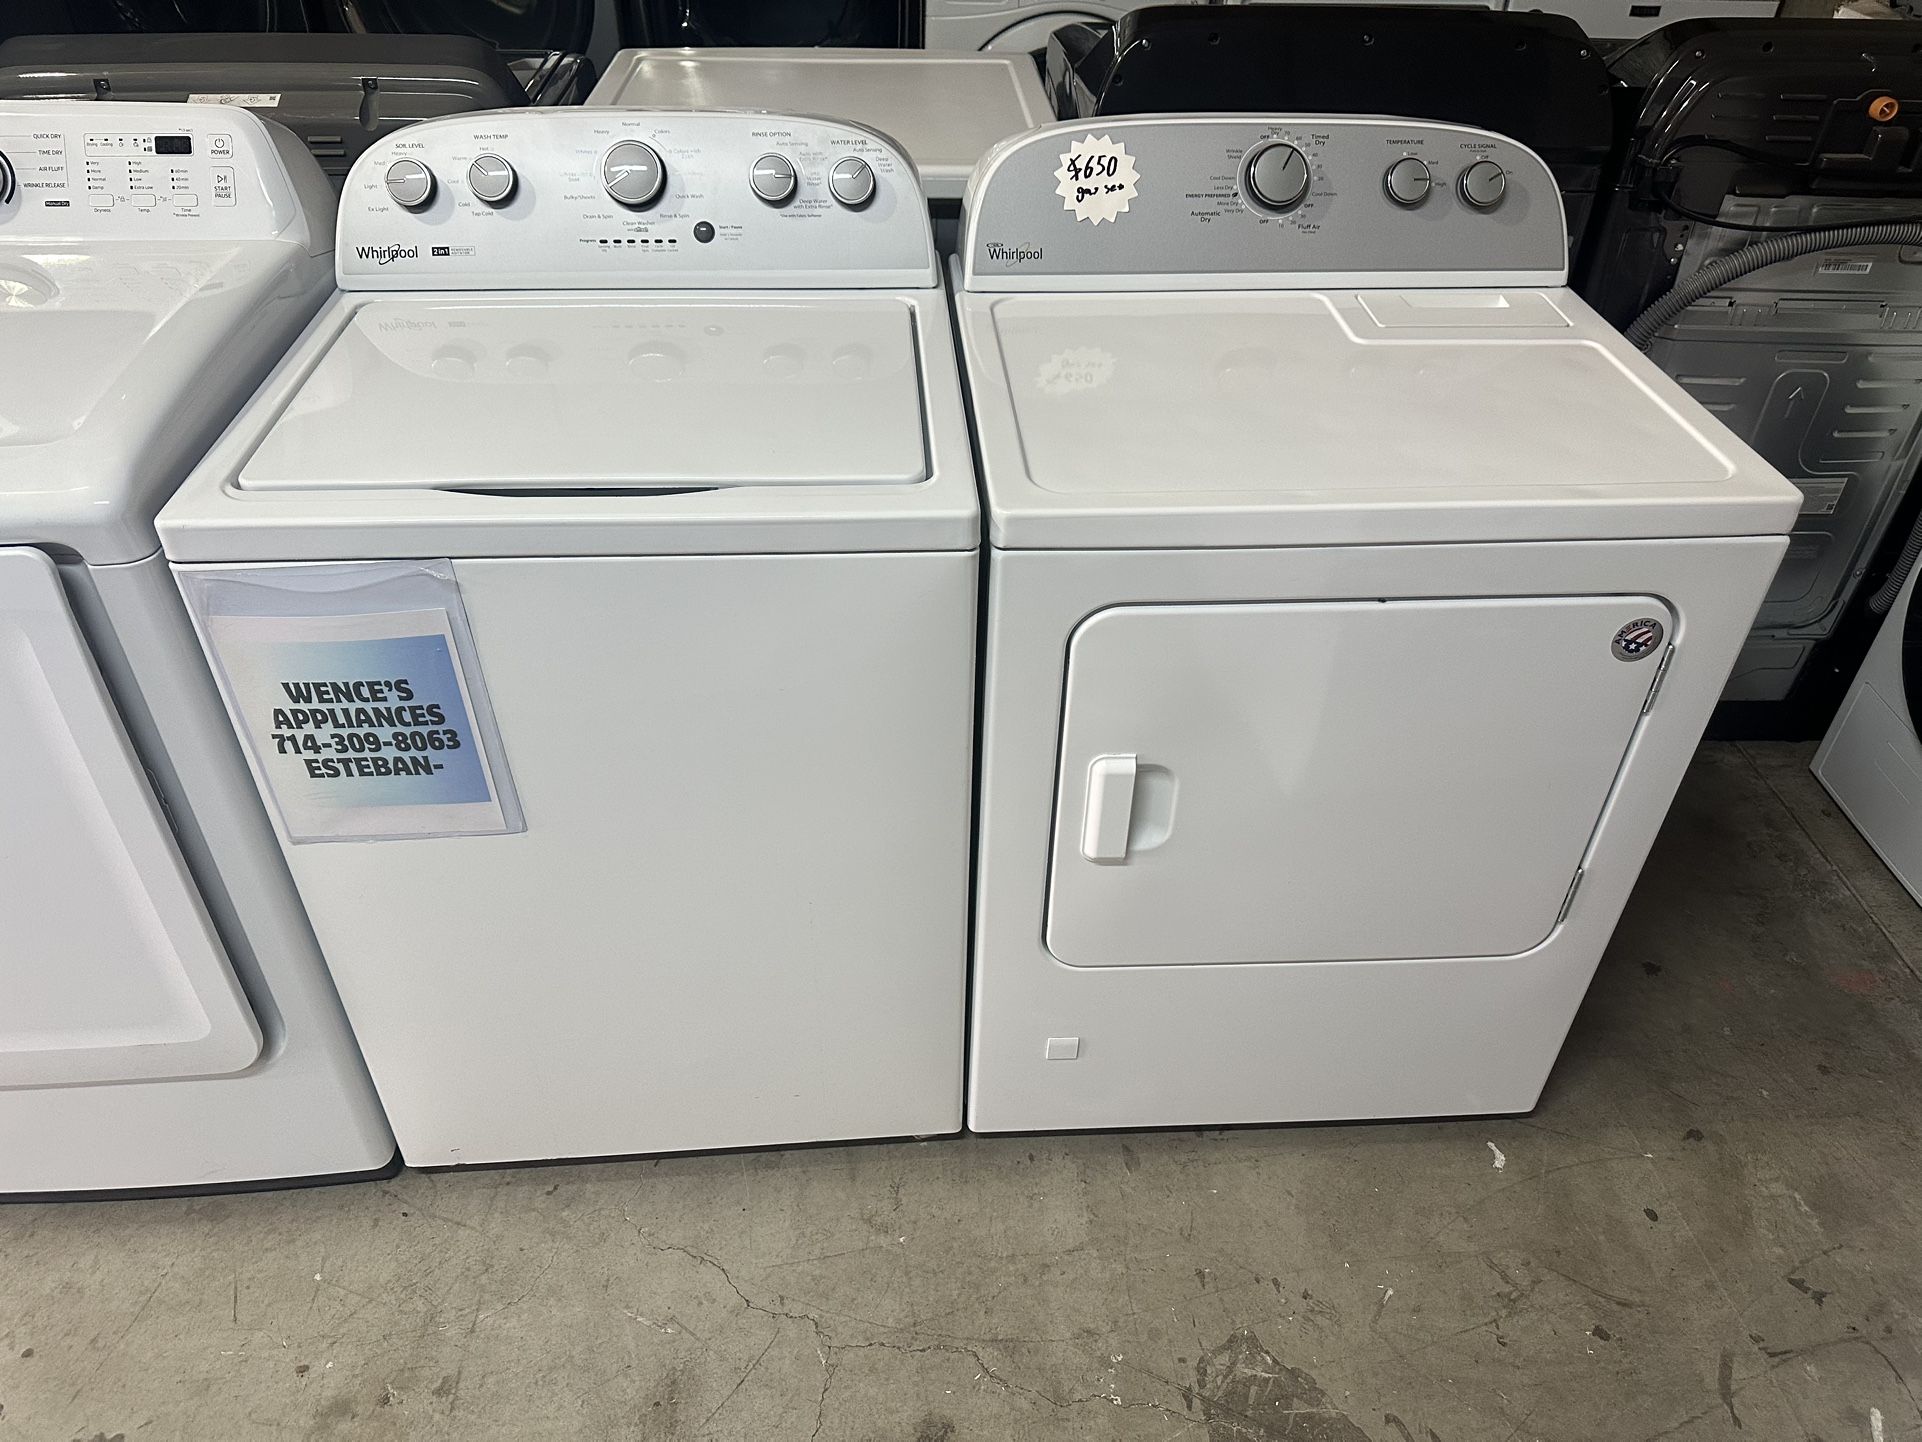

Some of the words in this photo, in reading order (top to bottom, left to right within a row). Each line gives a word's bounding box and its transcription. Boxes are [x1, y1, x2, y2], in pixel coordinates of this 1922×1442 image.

[1067, 154, 1118, 182] $650
[1104, 183, 1125, 194] set
[356, 244, 419, 265] Whirlpool
[988, 246, 1043, 264] Whirlpool
[281, 678, 414, 704] WENCE'S
[272, 703, 445, 730] APPLIANCES
[271, 729, 461, 754] 714-309-8063
[303, 755, 444, 779] ESTEBAN-
